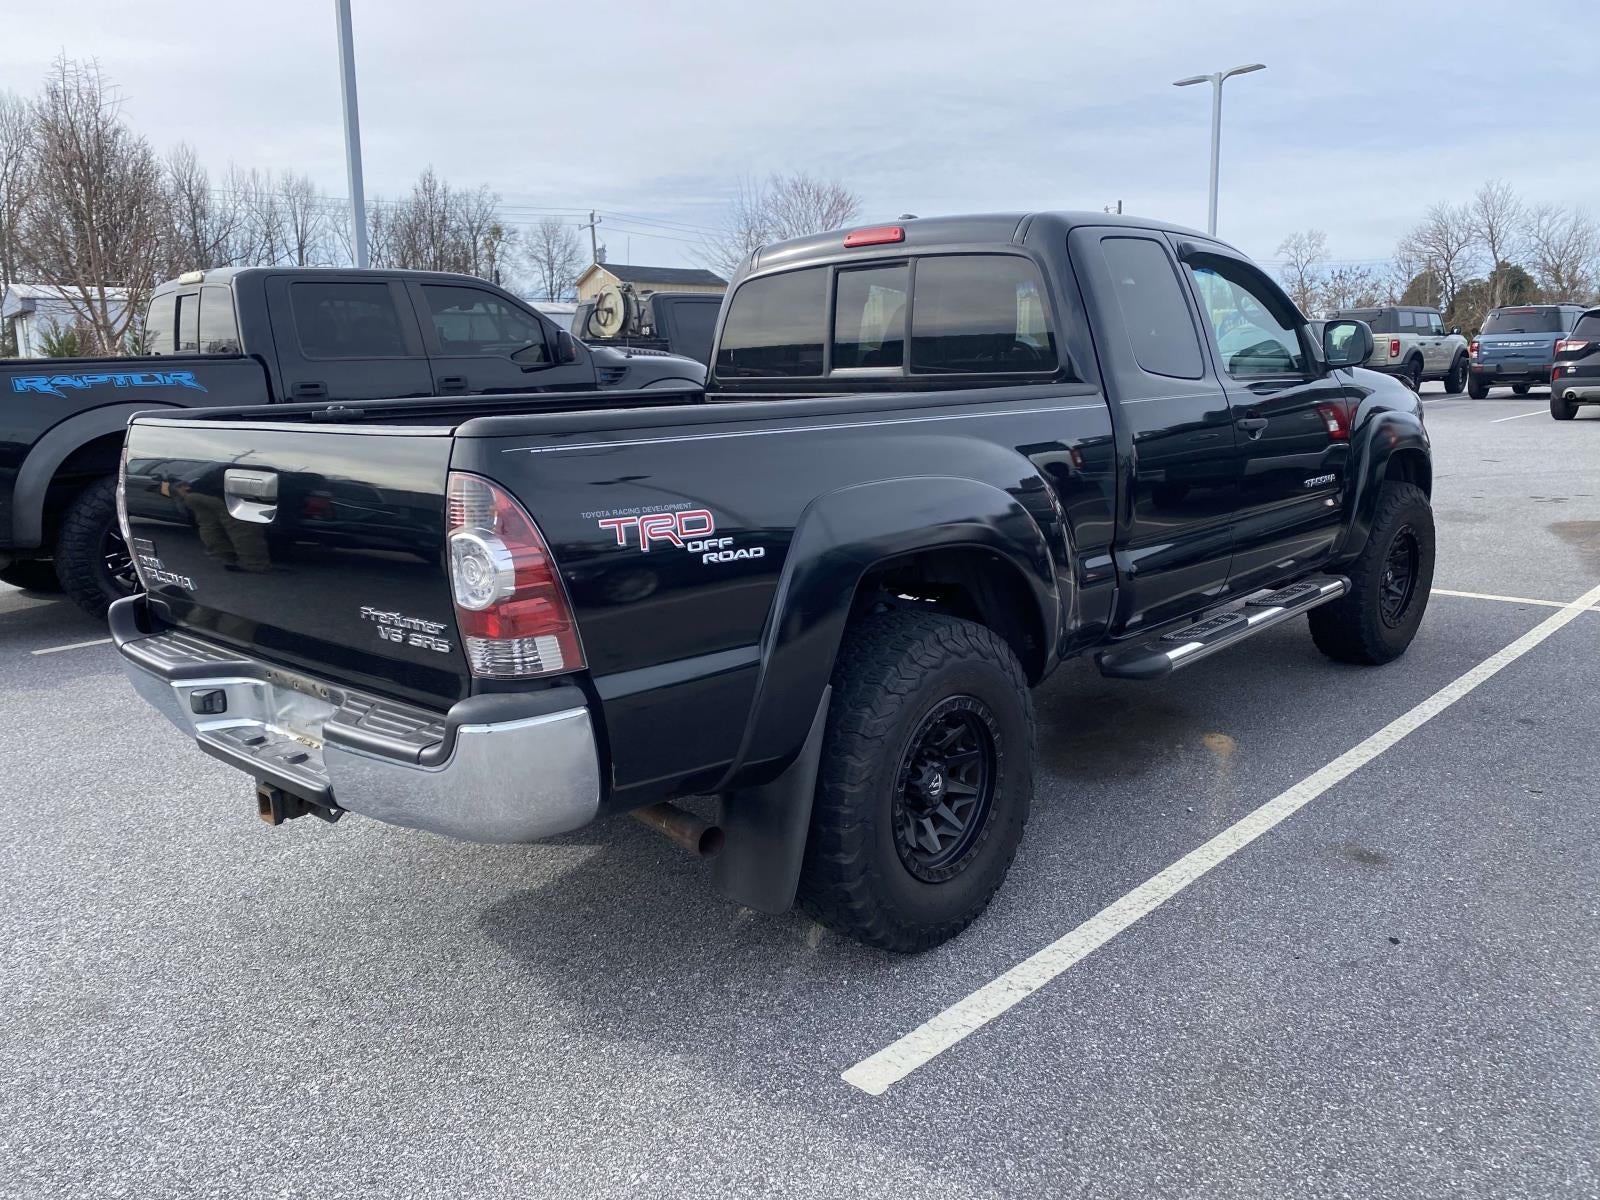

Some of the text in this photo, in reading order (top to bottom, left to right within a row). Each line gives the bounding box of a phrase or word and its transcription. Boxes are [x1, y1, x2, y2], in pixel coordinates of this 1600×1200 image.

[11, 372, 208, 398] RAPTOR
[581, 502, 692, 519] TOYOTA RACING DEVELOPMENT
[598, 509, 714, 552] TRD
[687, 537, 734, 553] OFF
[702, 546, 765, 564] ROAD
[360, 605, 448, 634] PreRunner
[377, 625, 453, 654] V6 SR5
